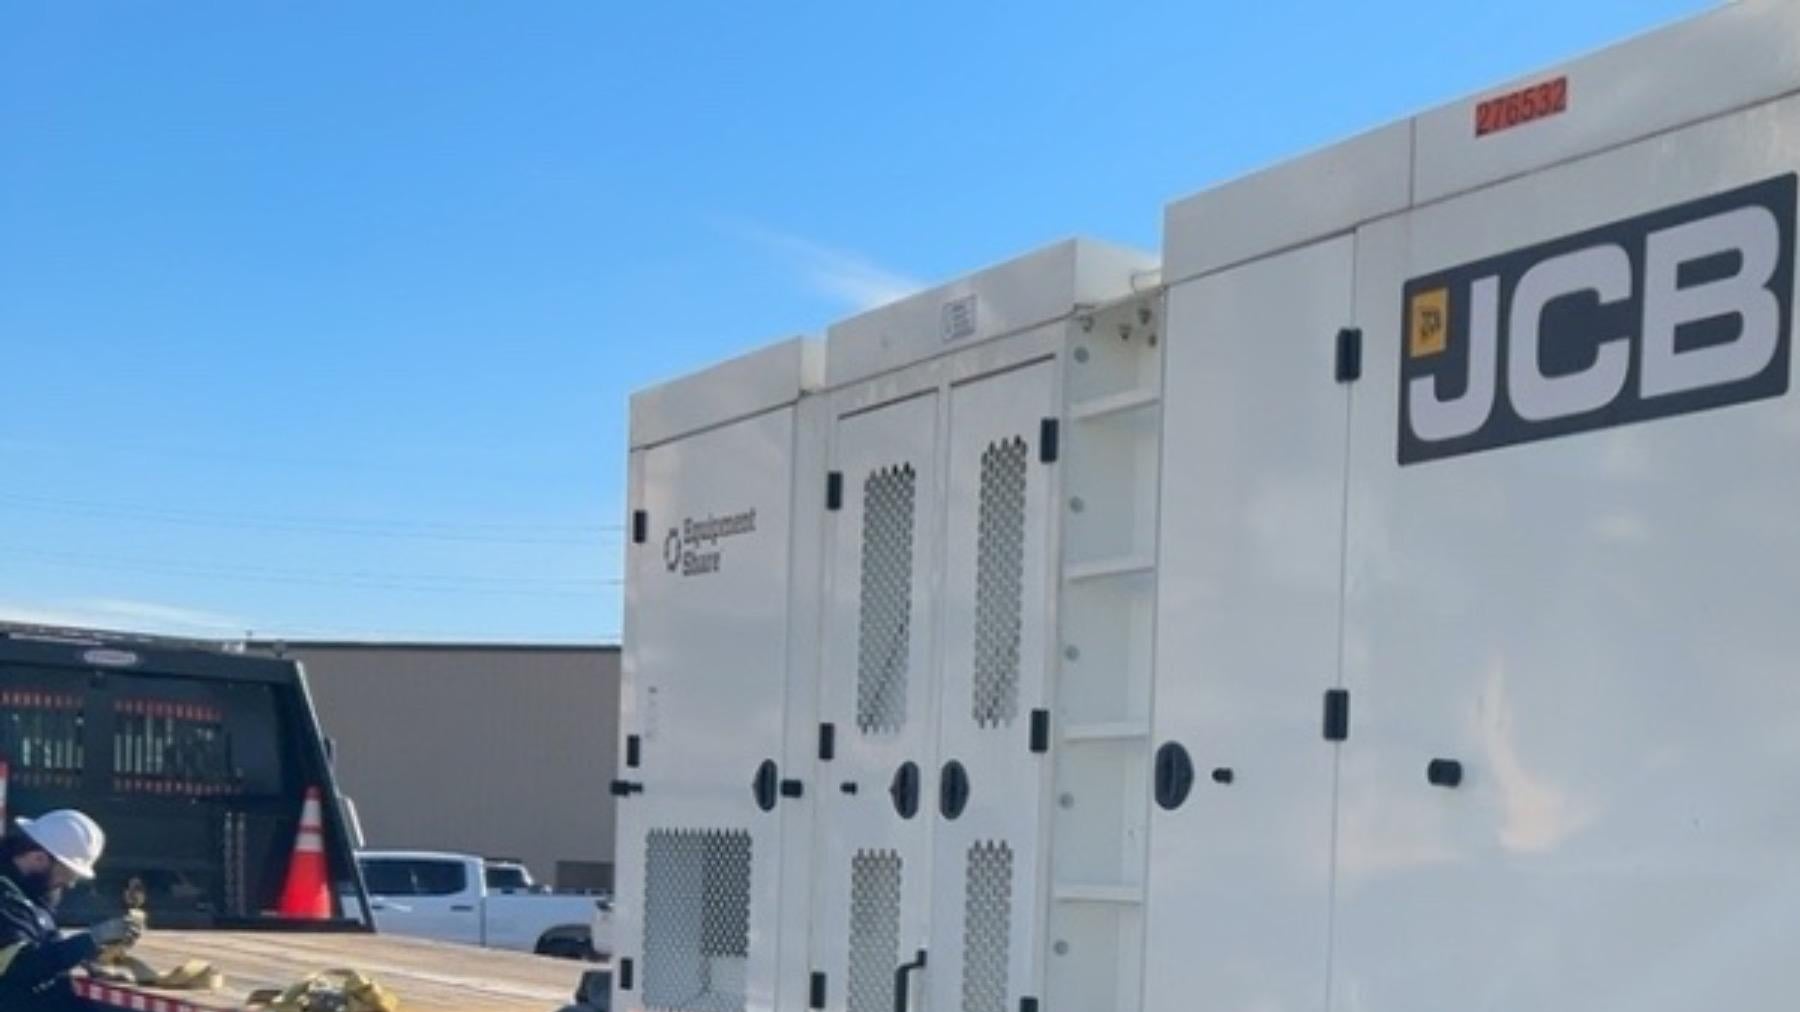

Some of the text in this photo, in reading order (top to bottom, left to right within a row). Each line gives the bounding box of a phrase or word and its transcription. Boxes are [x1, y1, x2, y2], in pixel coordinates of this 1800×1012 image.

[1475, 75, 1567, 139] 276532
[1409, 204, 1781, 442] JCB
[683, 507, 757, 549] Equipment
[683, 551, 721, 577] Share
